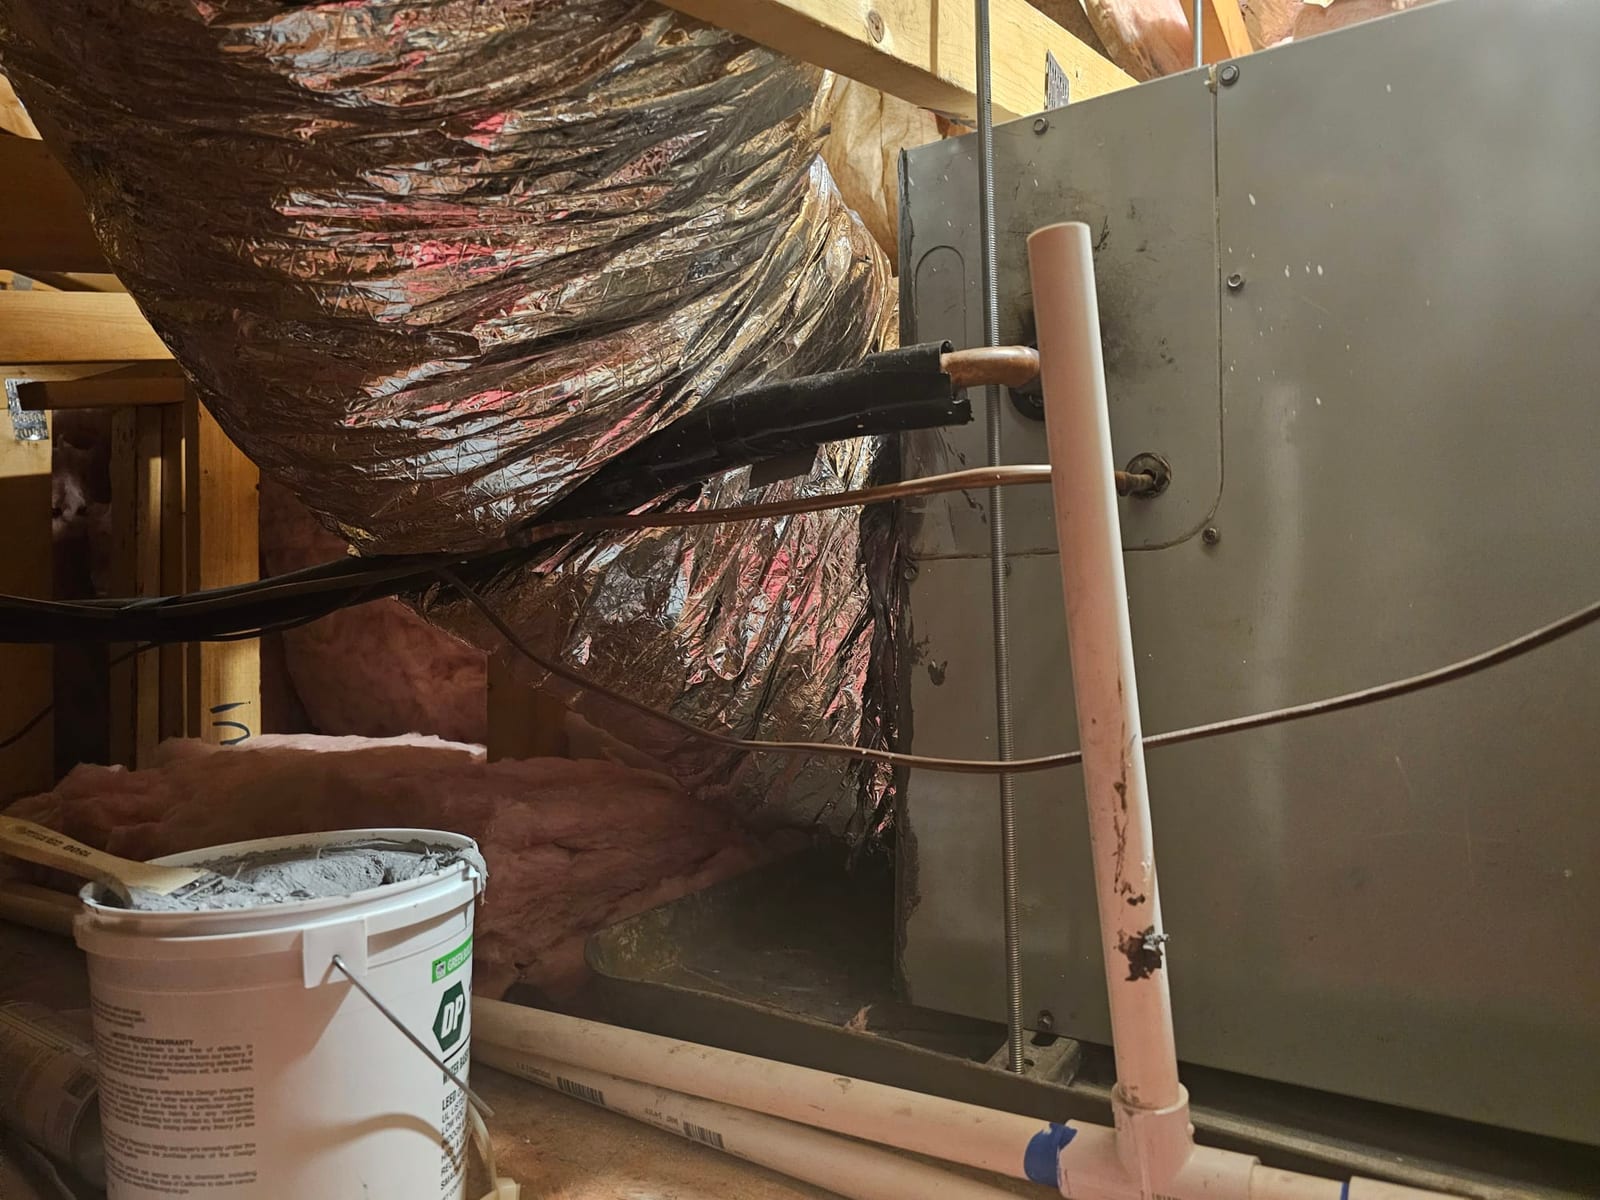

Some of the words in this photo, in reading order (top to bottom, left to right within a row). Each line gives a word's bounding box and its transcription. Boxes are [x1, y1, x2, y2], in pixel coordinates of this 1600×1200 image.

[440, 993, 464, 1039] DP
[155, 1039, 194, 1047] WARRANTY
[442, 1090, 456, 1111] LEED
